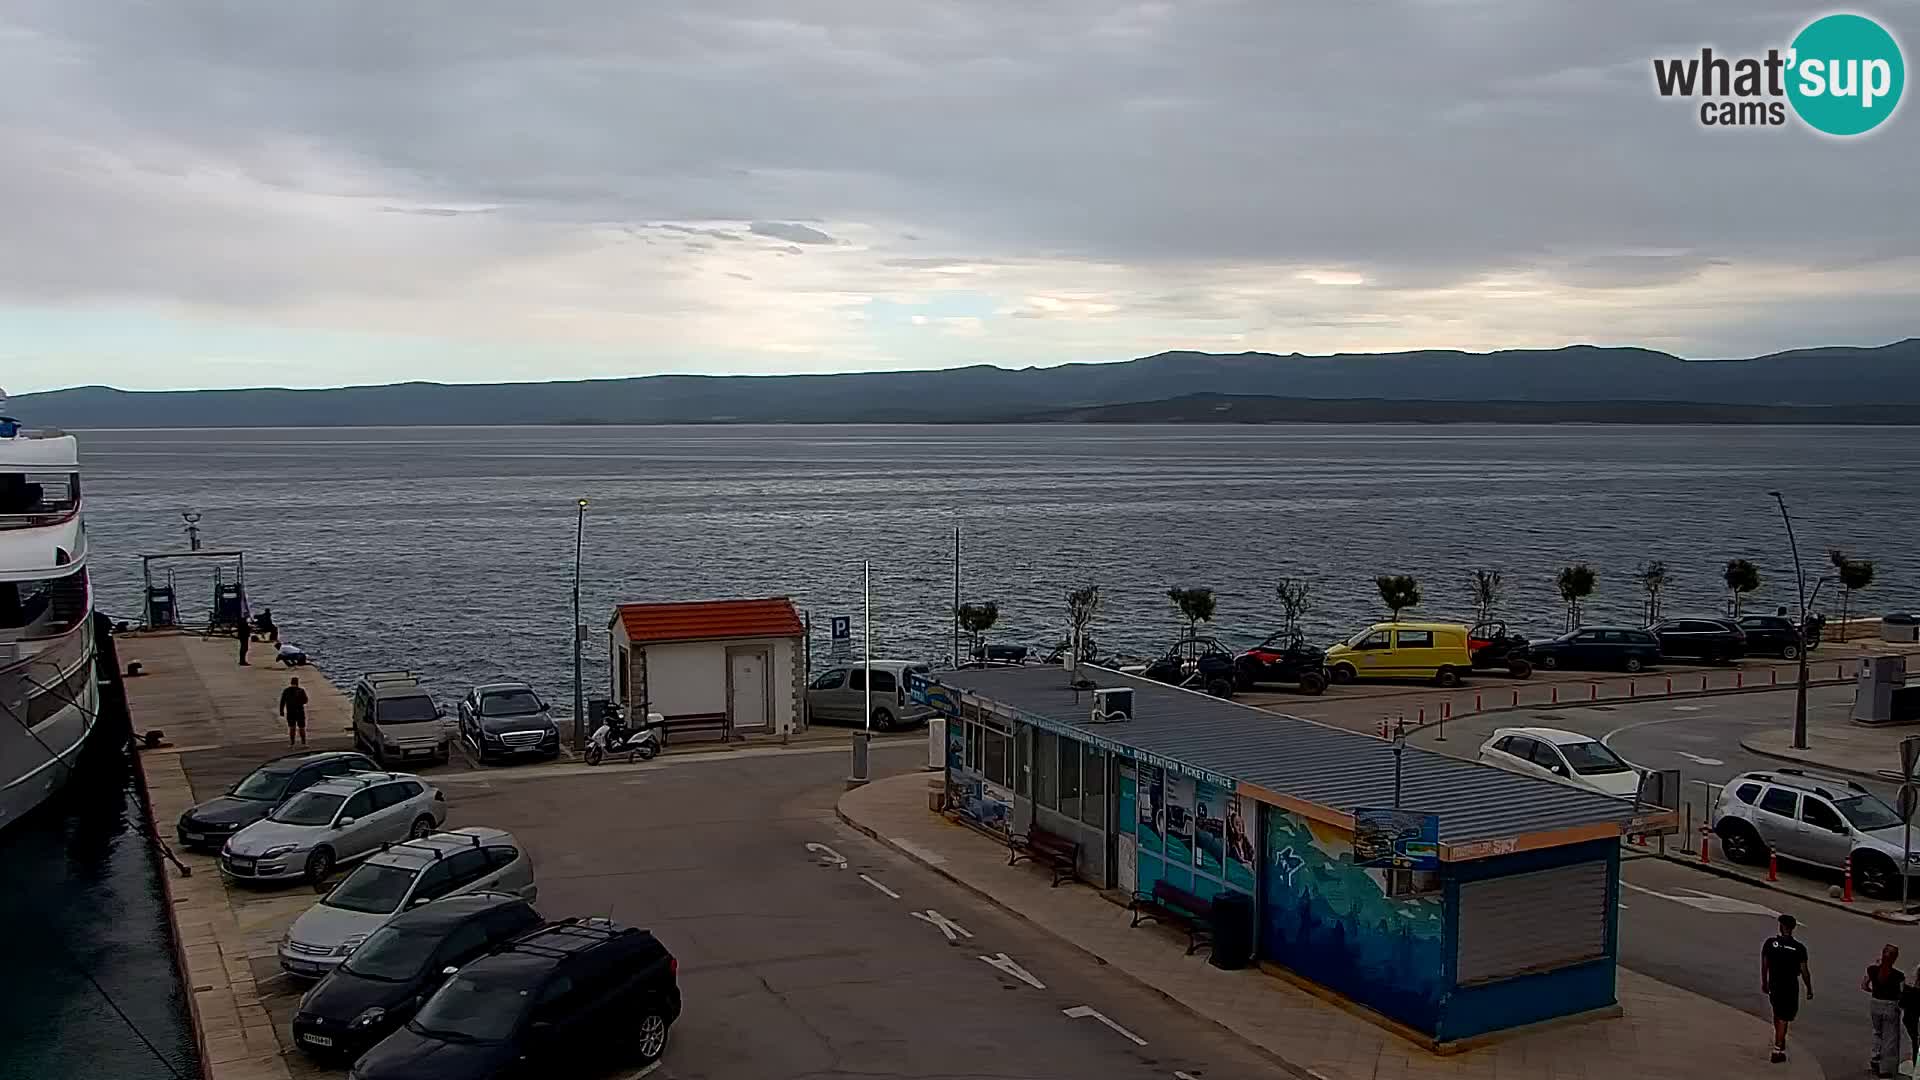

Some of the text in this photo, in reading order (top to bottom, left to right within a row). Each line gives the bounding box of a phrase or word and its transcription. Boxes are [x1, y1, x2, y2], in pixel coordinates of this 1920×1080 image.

[836, 619, 846, 636] P
[1134, 749, 1148, 762] BUS
[1148, 755, 1178, 771] STATION
[1180, 764, 1205, 780] TICKET
[1206, 774, 1233, 789] OFFICE
